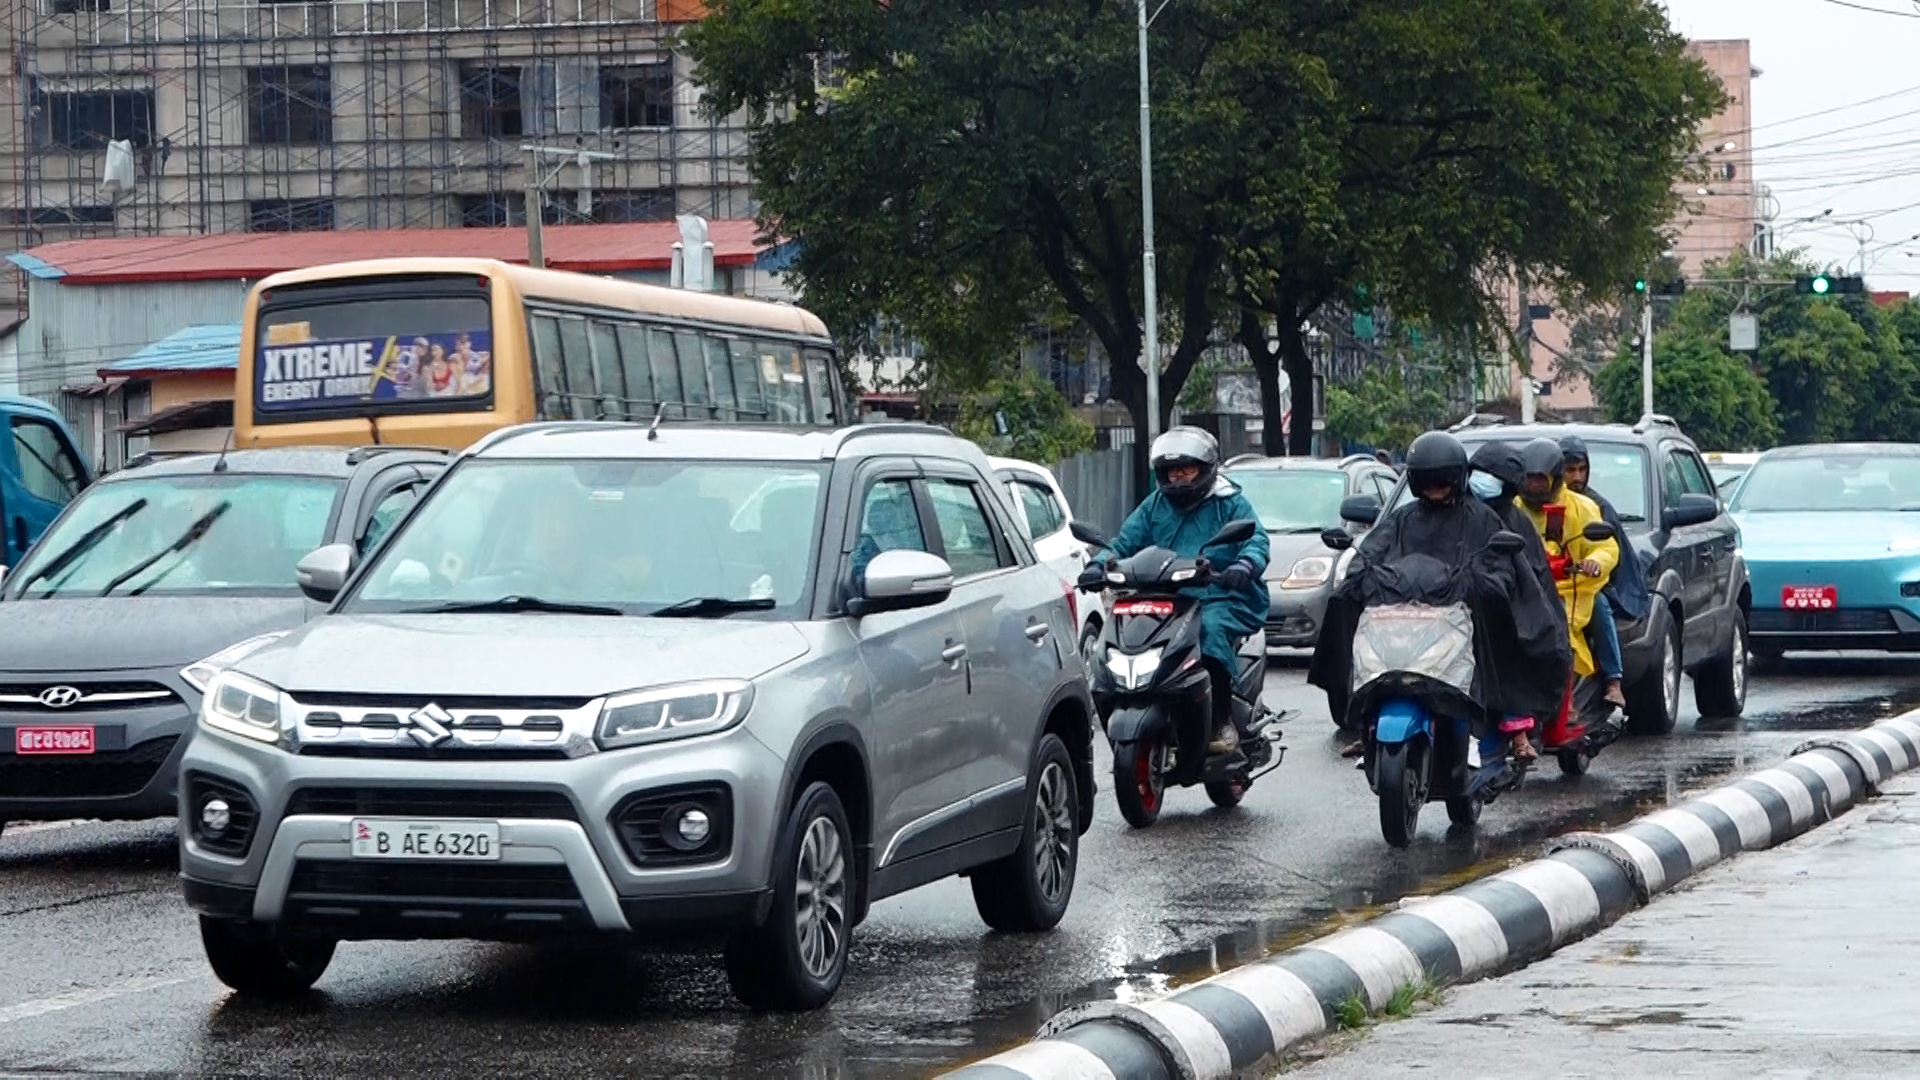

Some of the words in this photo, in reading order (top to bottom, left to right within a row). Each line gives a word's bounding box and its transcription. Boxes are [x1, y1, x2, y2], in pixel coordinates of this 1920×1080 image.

[263, 342, 373, 382] XTREME
[263, 380, 321, 402] ENERGY
[377, 831, 391, 853] B
[403, 832, 489, 856] AE6320
